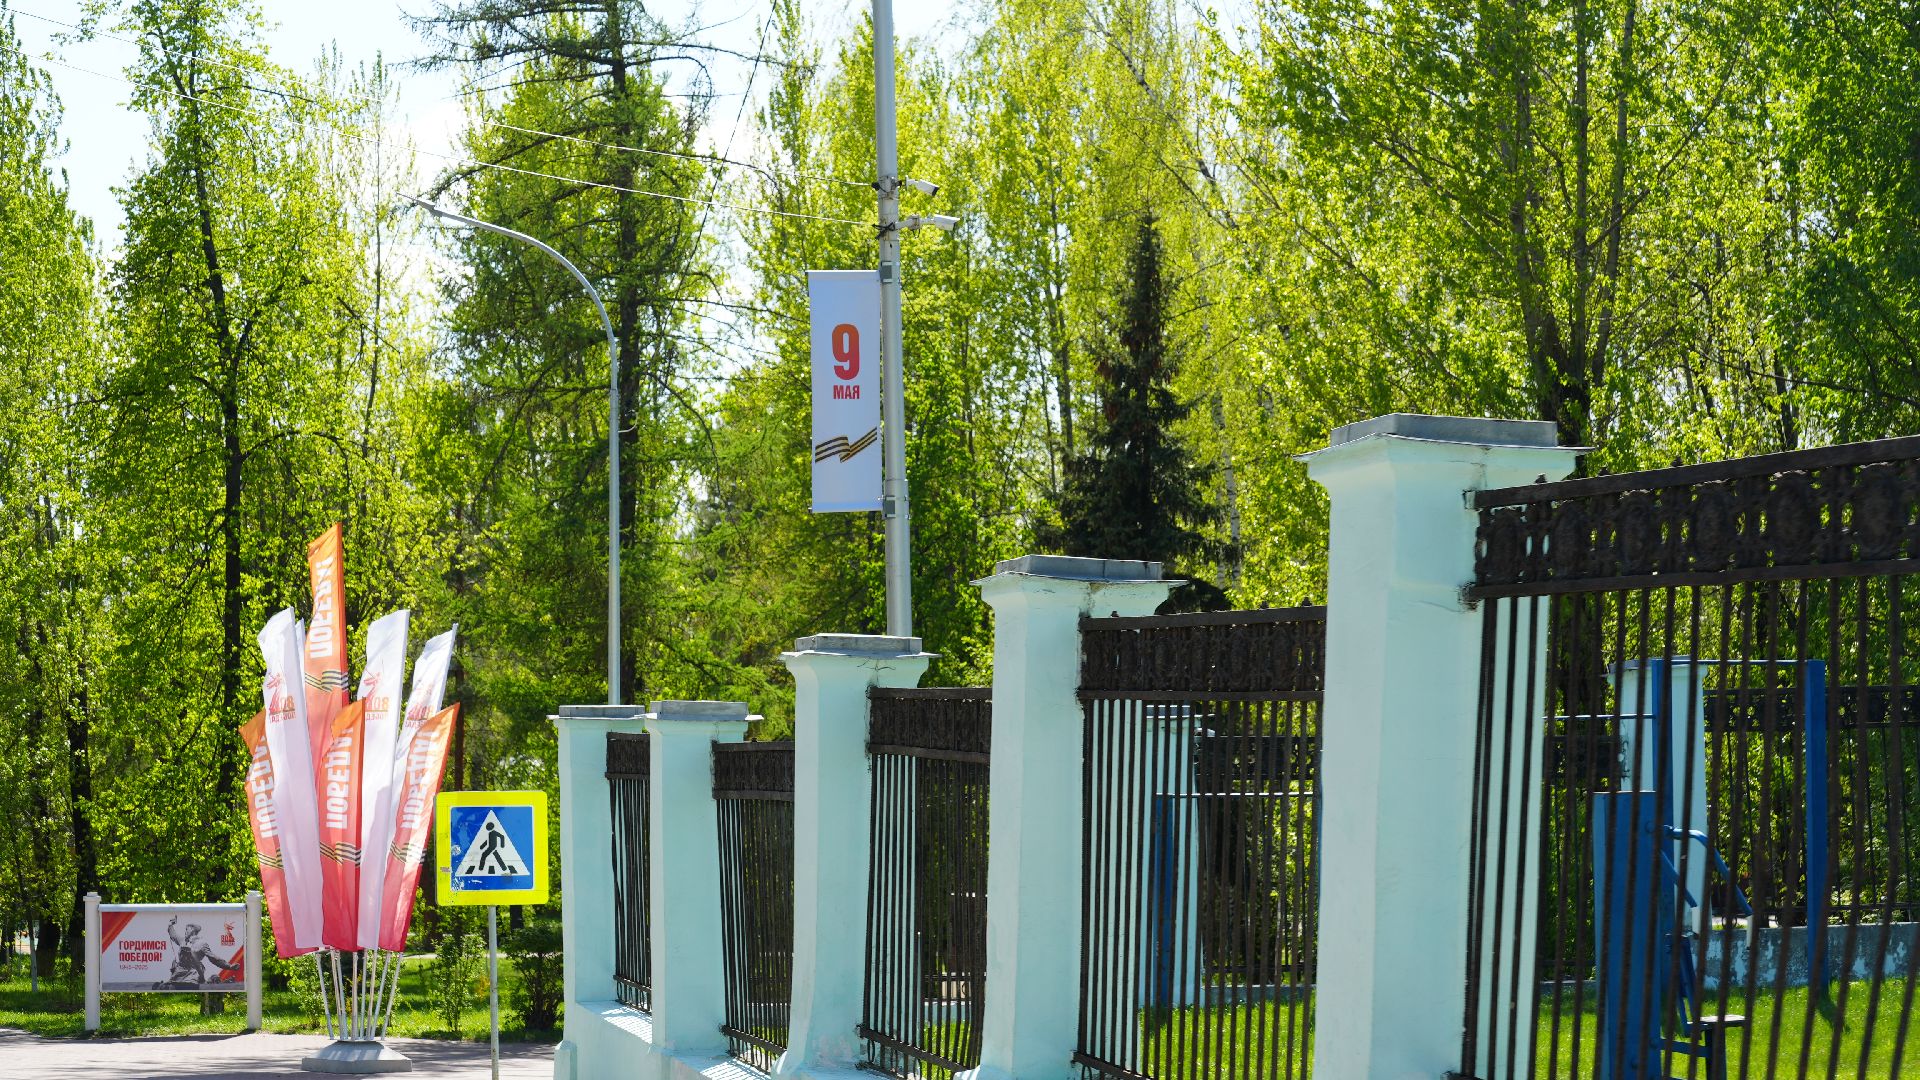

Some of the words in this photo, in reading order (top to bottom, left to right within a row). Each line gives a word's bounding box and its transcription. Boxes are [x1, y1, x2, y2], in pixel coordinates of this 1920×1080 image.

[832, 323, 860, 380] 9
[833, 384, 860, 400] МАЯ
[119, 940, 167, 951] ГОРДИМСЯ
[119, 952, 162, 963] ПОБЕДОЙ!
